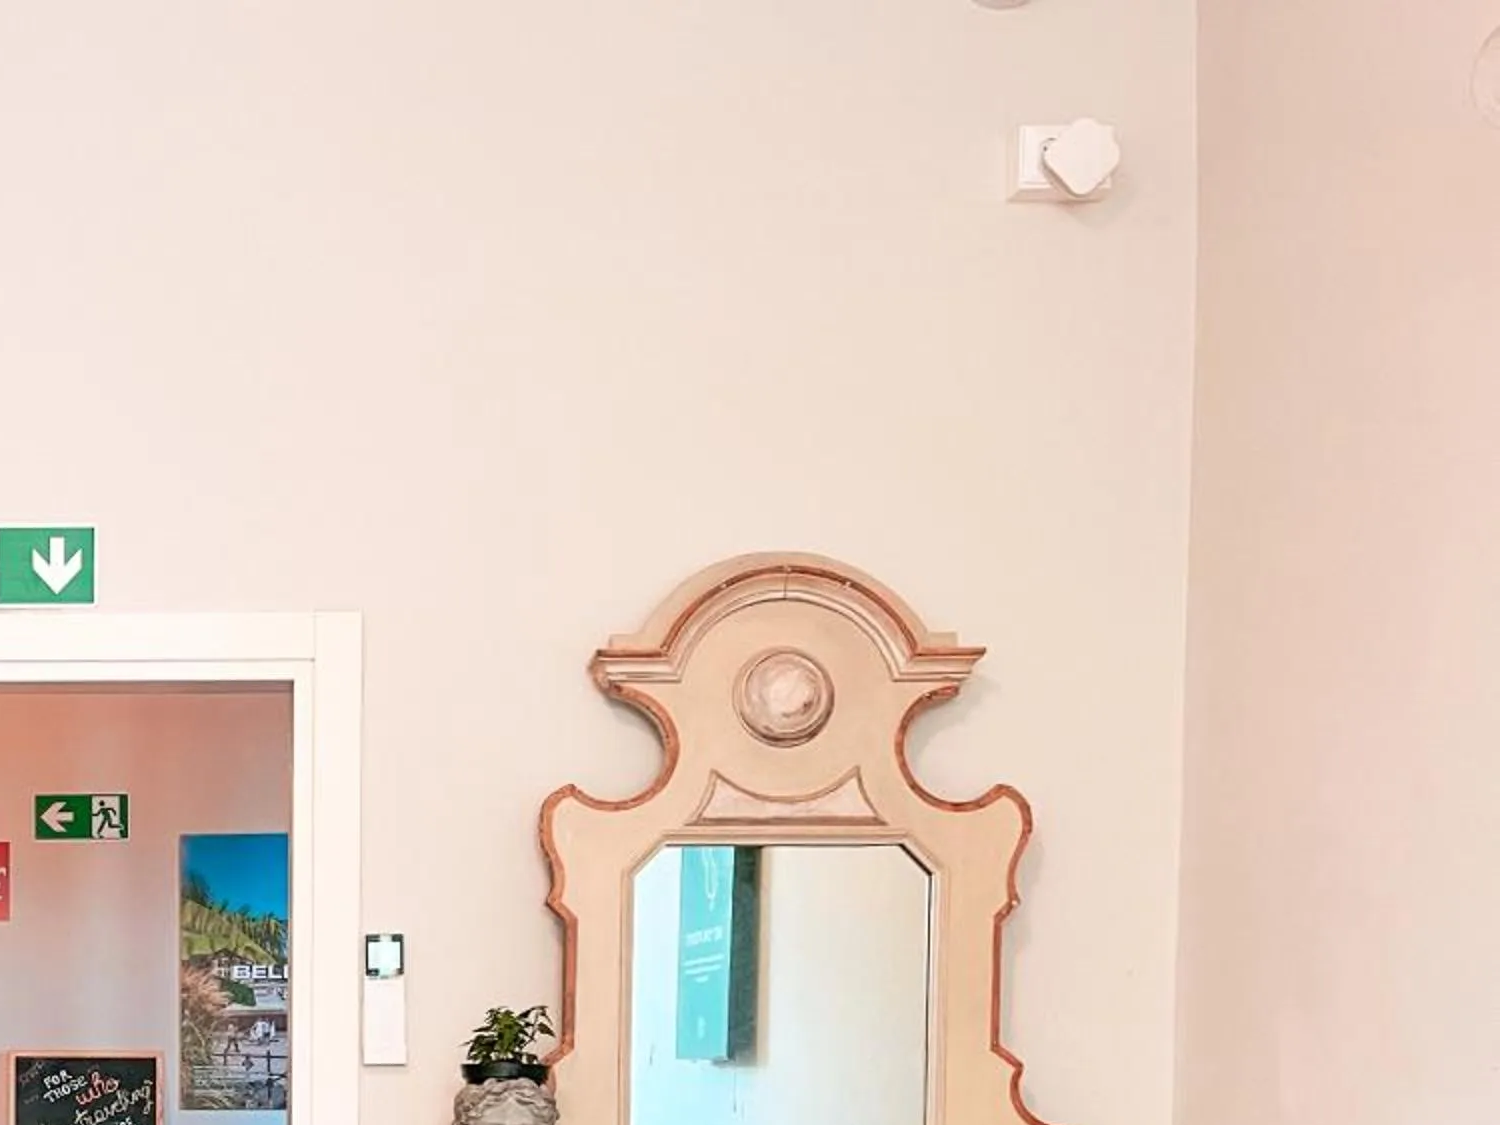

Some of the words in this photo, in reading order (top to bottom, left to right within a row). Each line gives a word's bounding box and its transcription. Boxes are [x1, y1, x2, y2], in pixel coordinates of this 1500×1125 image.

[43, 1069, 73, 1089] FOR
[43, 1074, 88, 1103] THOSE
[75, 1071, 120, 1106] who
